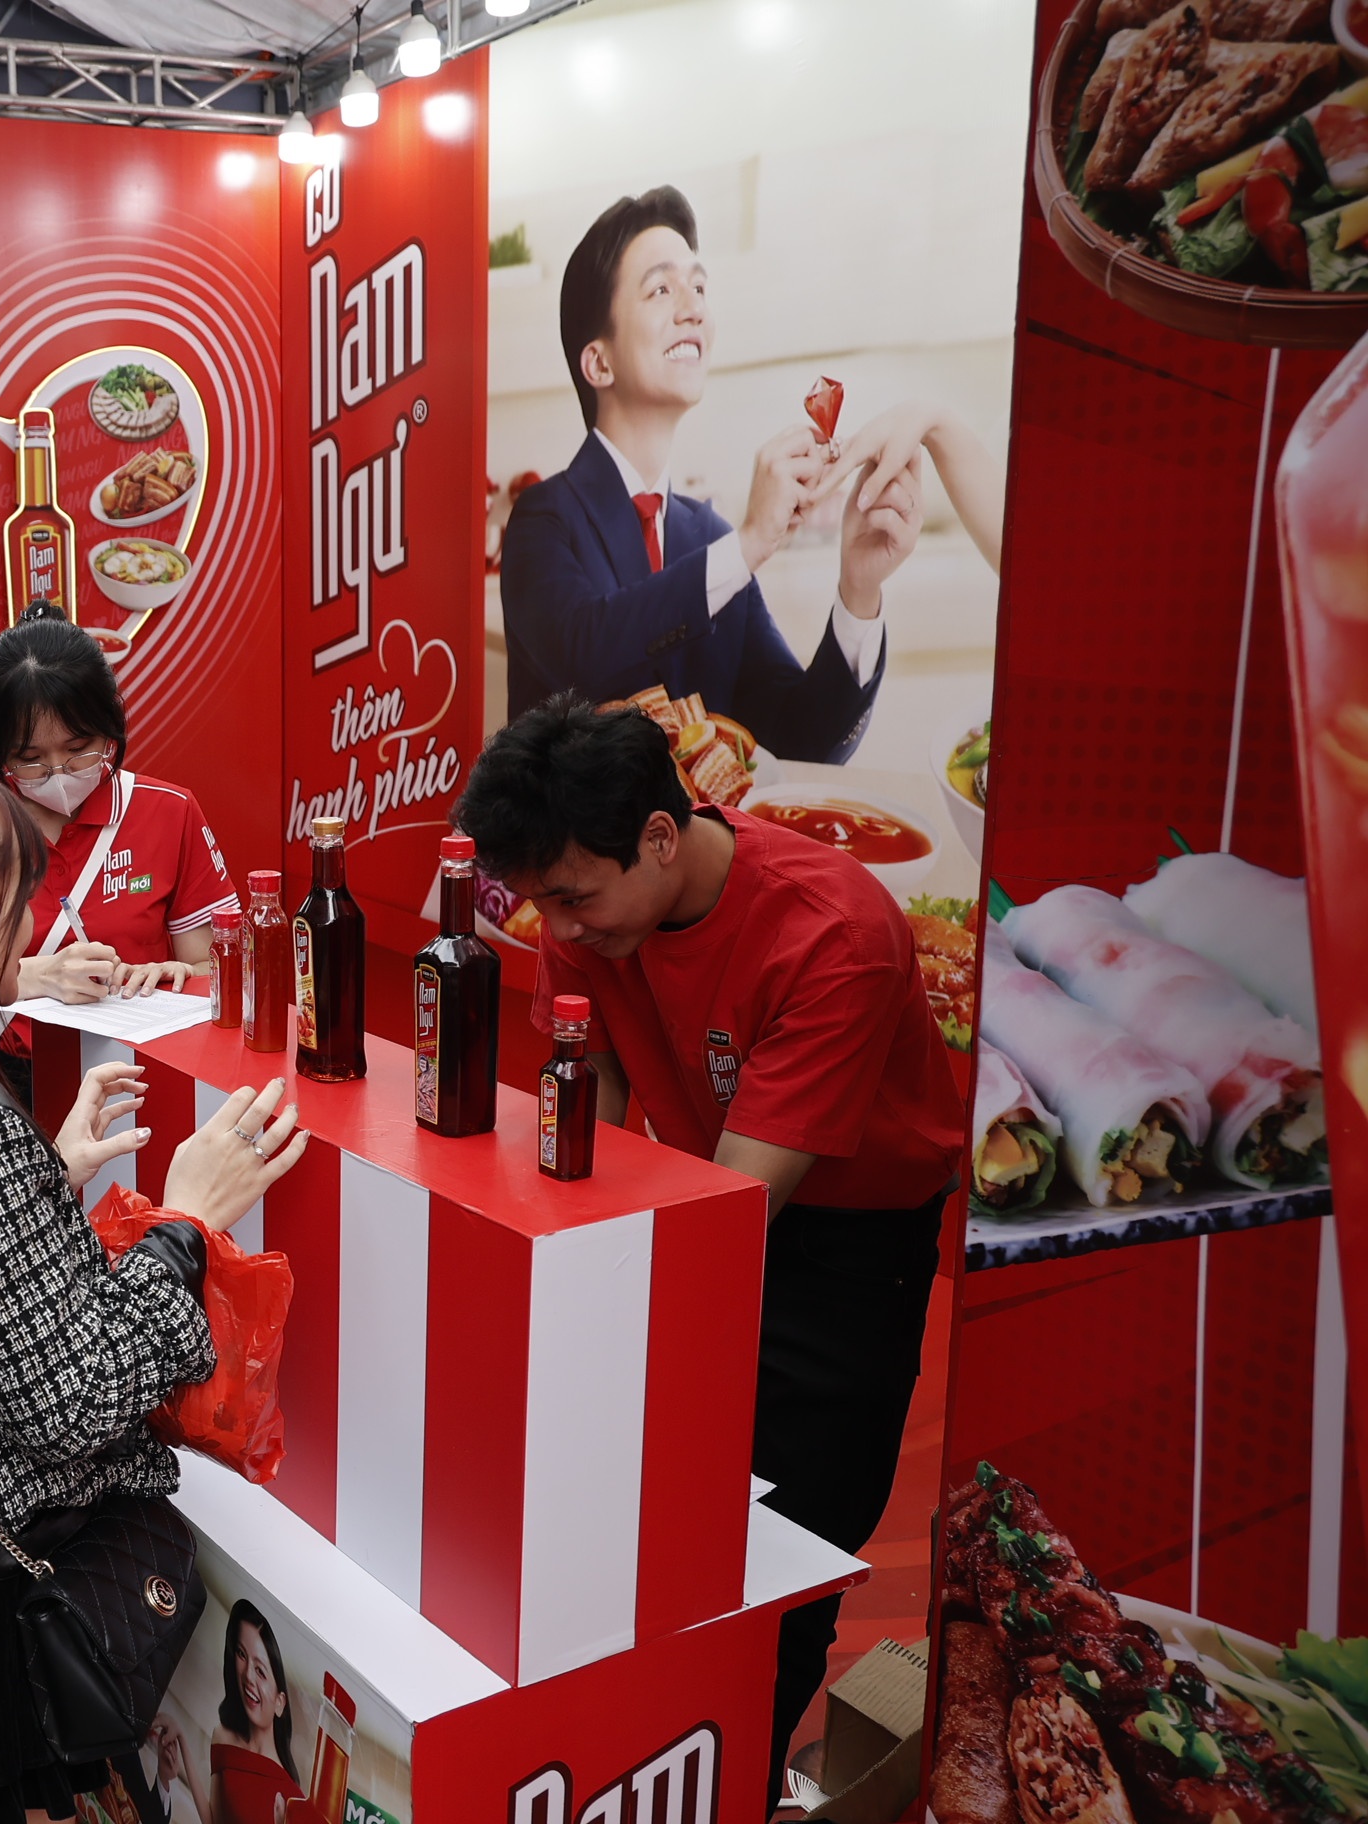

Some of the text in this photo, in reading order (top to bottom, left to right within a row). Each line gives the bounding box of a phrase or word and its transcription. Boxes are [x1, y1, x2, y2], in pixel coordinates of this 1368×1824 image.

[309, 243, 424, 432] Nam
[29, 545, 54, 570] Nam
[311, 418, 407, 670] Ngư
[331, 685, 405, 753] thêm
[368, 736, 460, 841] phúc
[104, 849, 132, 873] Nam
[103, 870, 151, 904] Ngư MỚI
[419, 982, 436, 1005] Nam
[419, 1005, 434, 1037] Ngư
[708, 1050, 737, 1072] Nam
